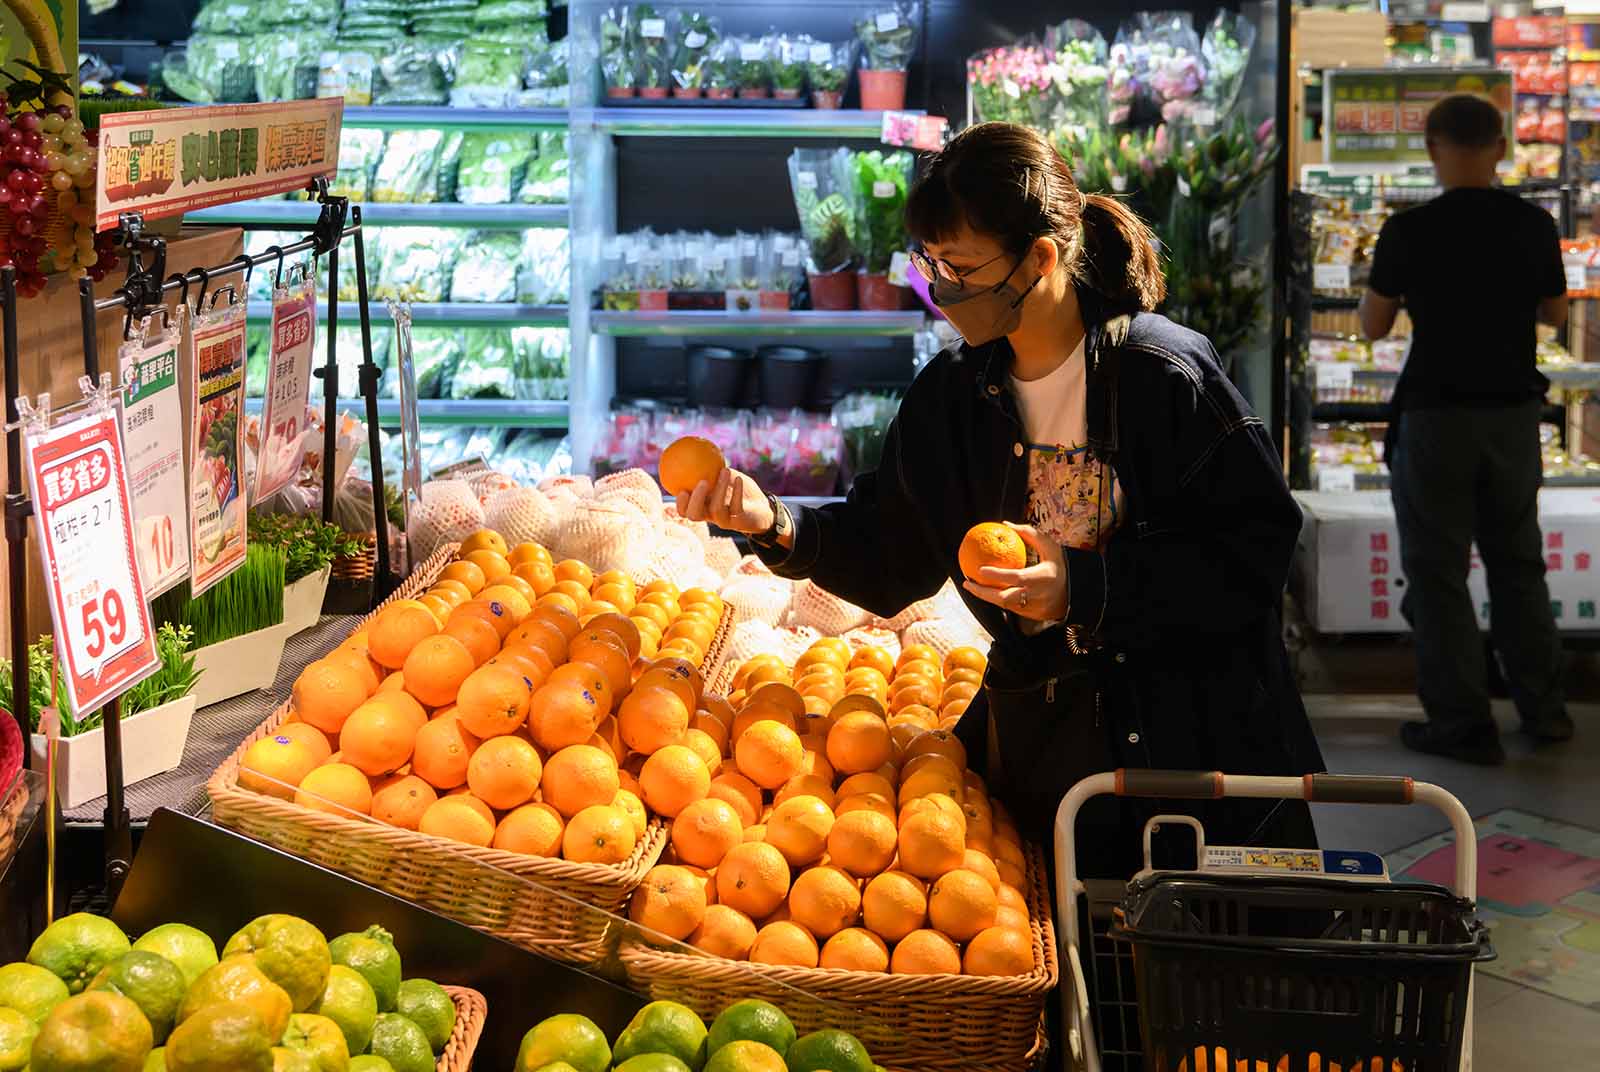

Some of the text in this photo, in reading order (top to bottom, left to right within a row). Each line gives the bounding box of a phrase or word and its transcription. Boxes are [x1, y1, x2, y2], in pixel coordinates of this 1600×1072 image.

[43, 453, 107, 507] 買多省多
[81, 588, 127, 658] 59
